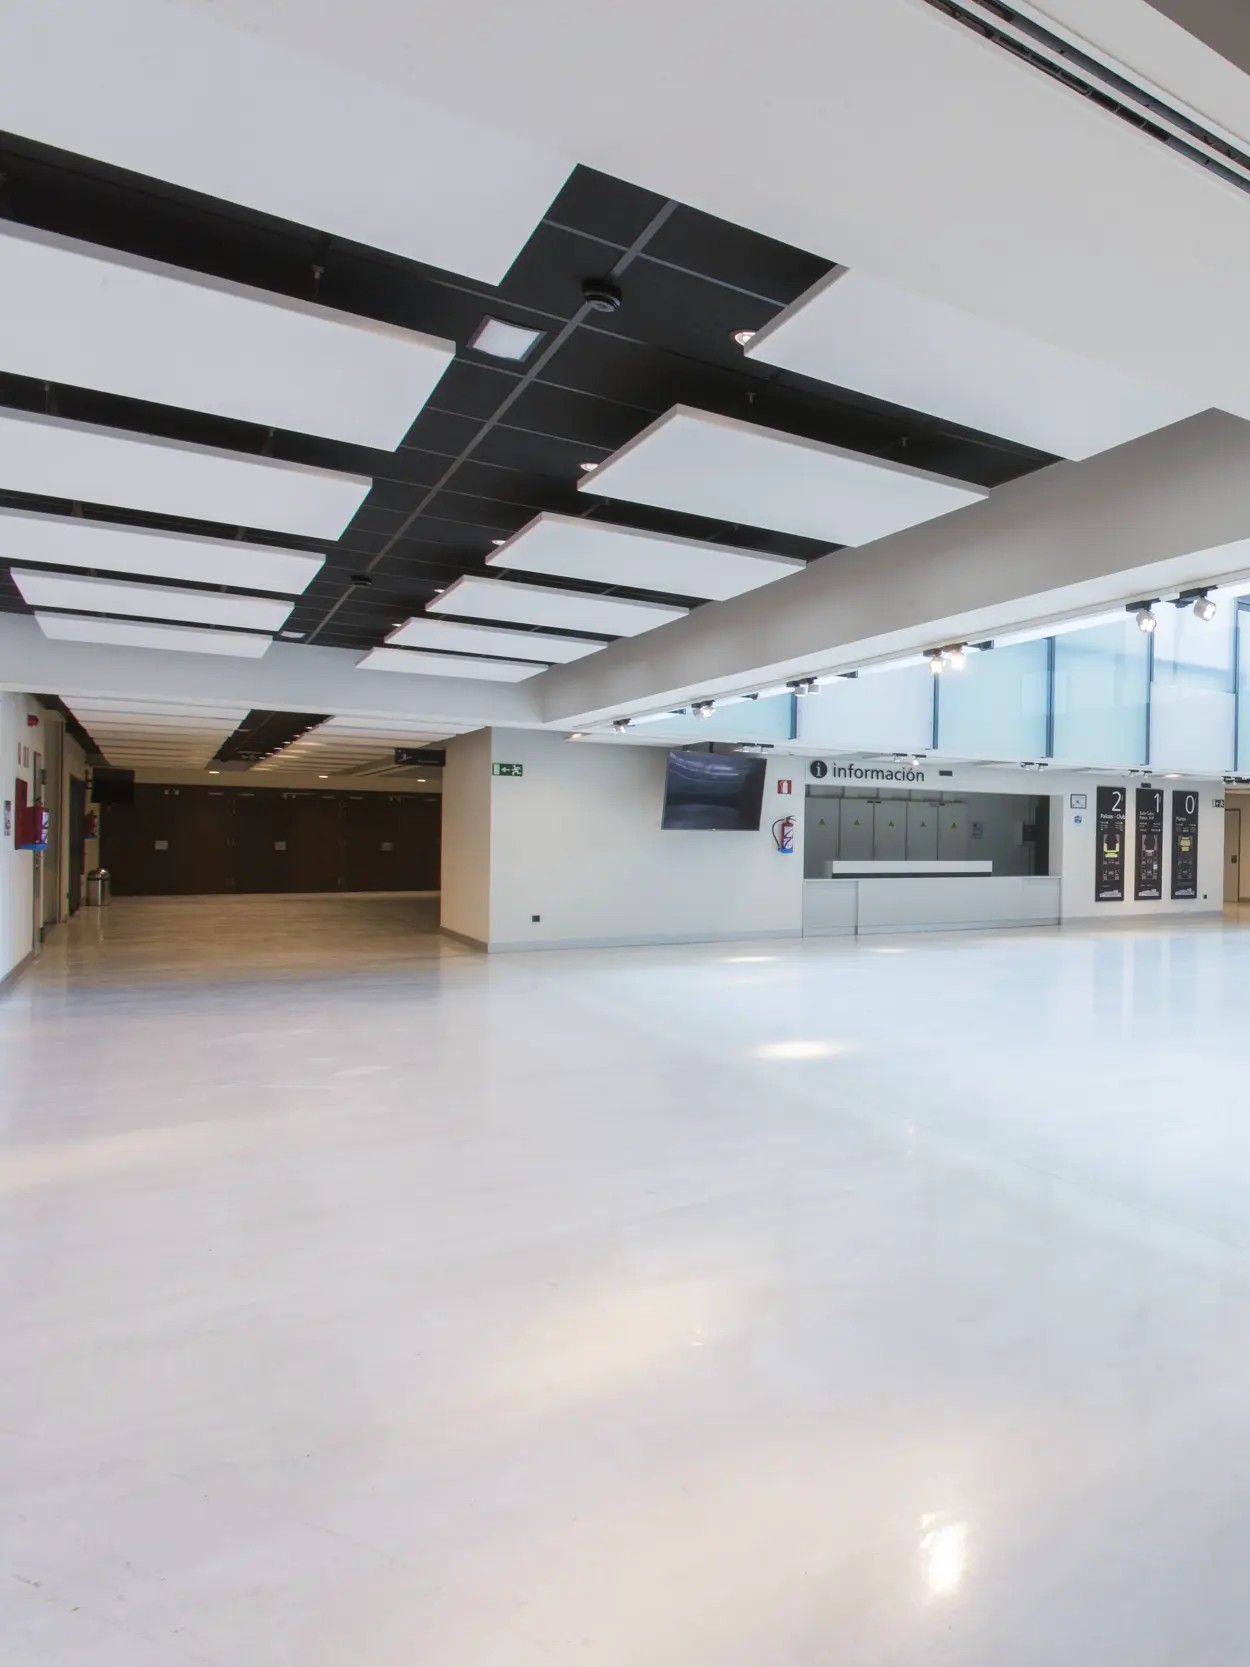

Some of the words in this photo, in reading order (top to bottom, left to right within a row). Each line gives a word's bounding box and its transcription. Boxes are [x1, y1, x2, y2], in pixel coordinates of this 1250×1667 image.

[832, 763, 925, 782] información
[1111, 791, 1121, 812] 2
[1153, 793, 1160, 813] 1
[1185, 795, 1195, 814] 0
